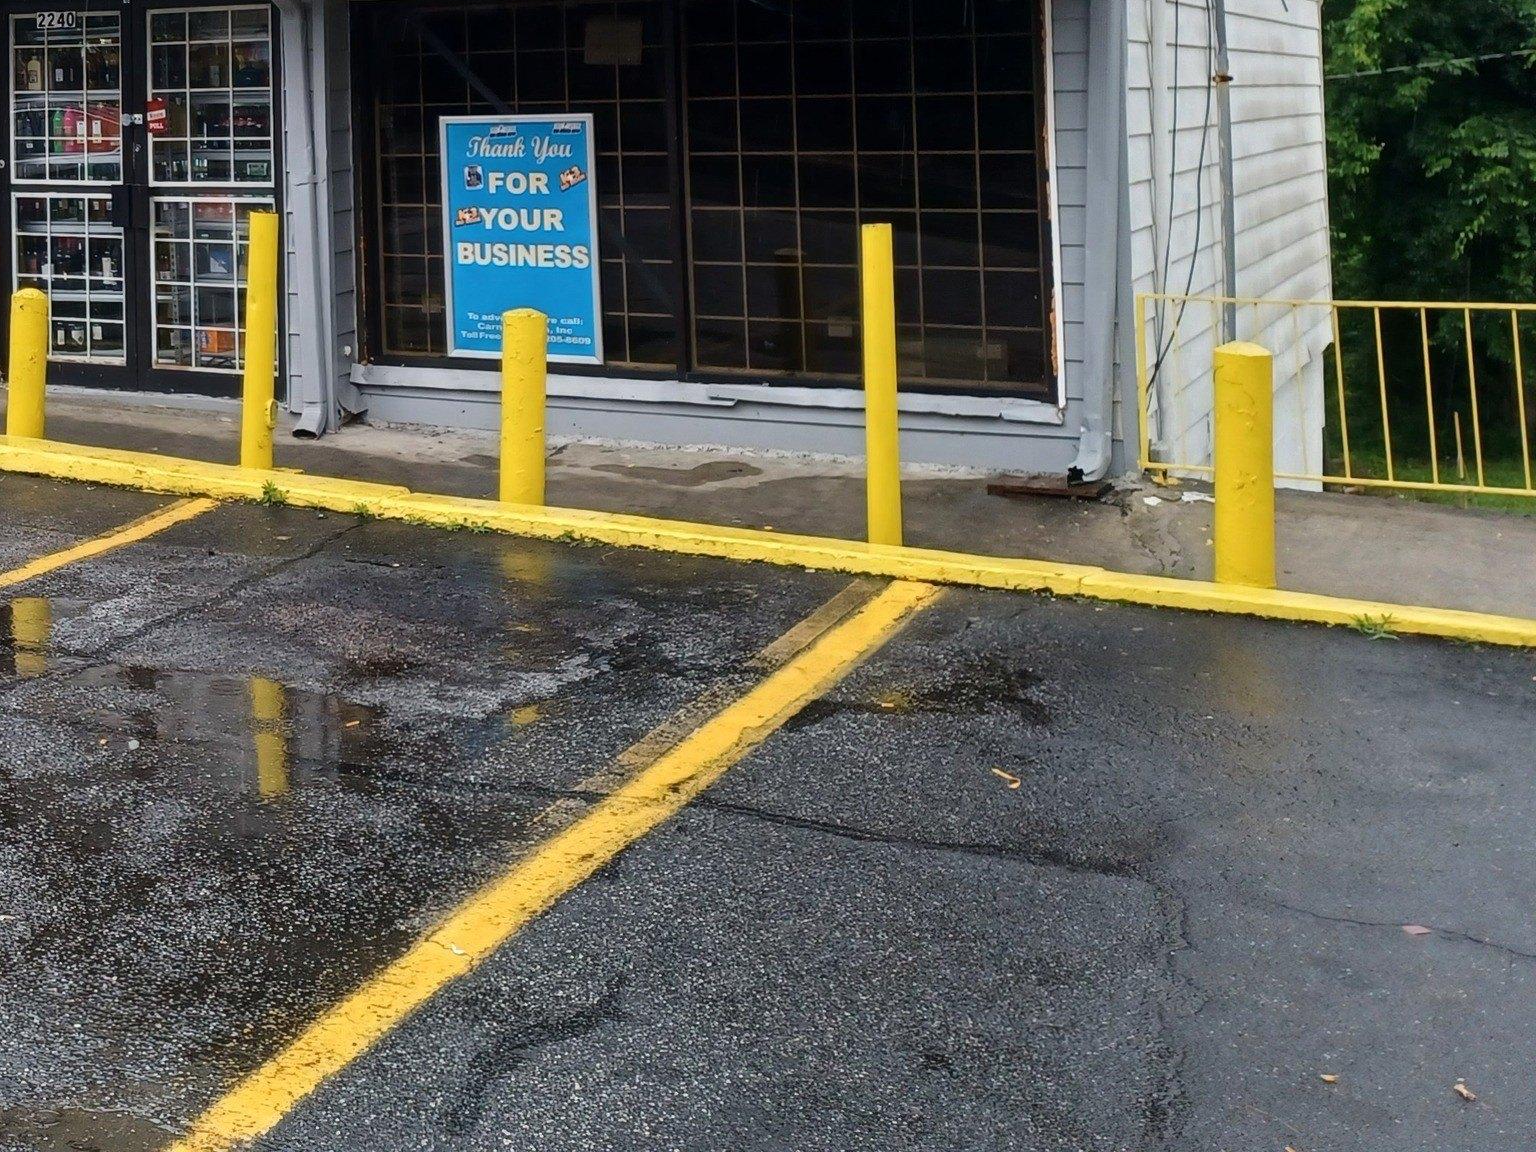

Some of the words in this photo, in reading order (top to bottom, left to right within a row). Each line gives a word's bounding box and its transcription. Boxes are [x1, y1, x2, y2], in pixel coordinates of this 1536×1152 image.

[38, 12, 75, 28] 2240
[466, 136, 526, 158] Thank
[531, 136, 573, 164] You
[488, 171, 551, 195] FOR
[480, 207, 565, 232] YOUR
[457, 241, 590, 269] BUSINESS
[467, 312, 479, 320] To
